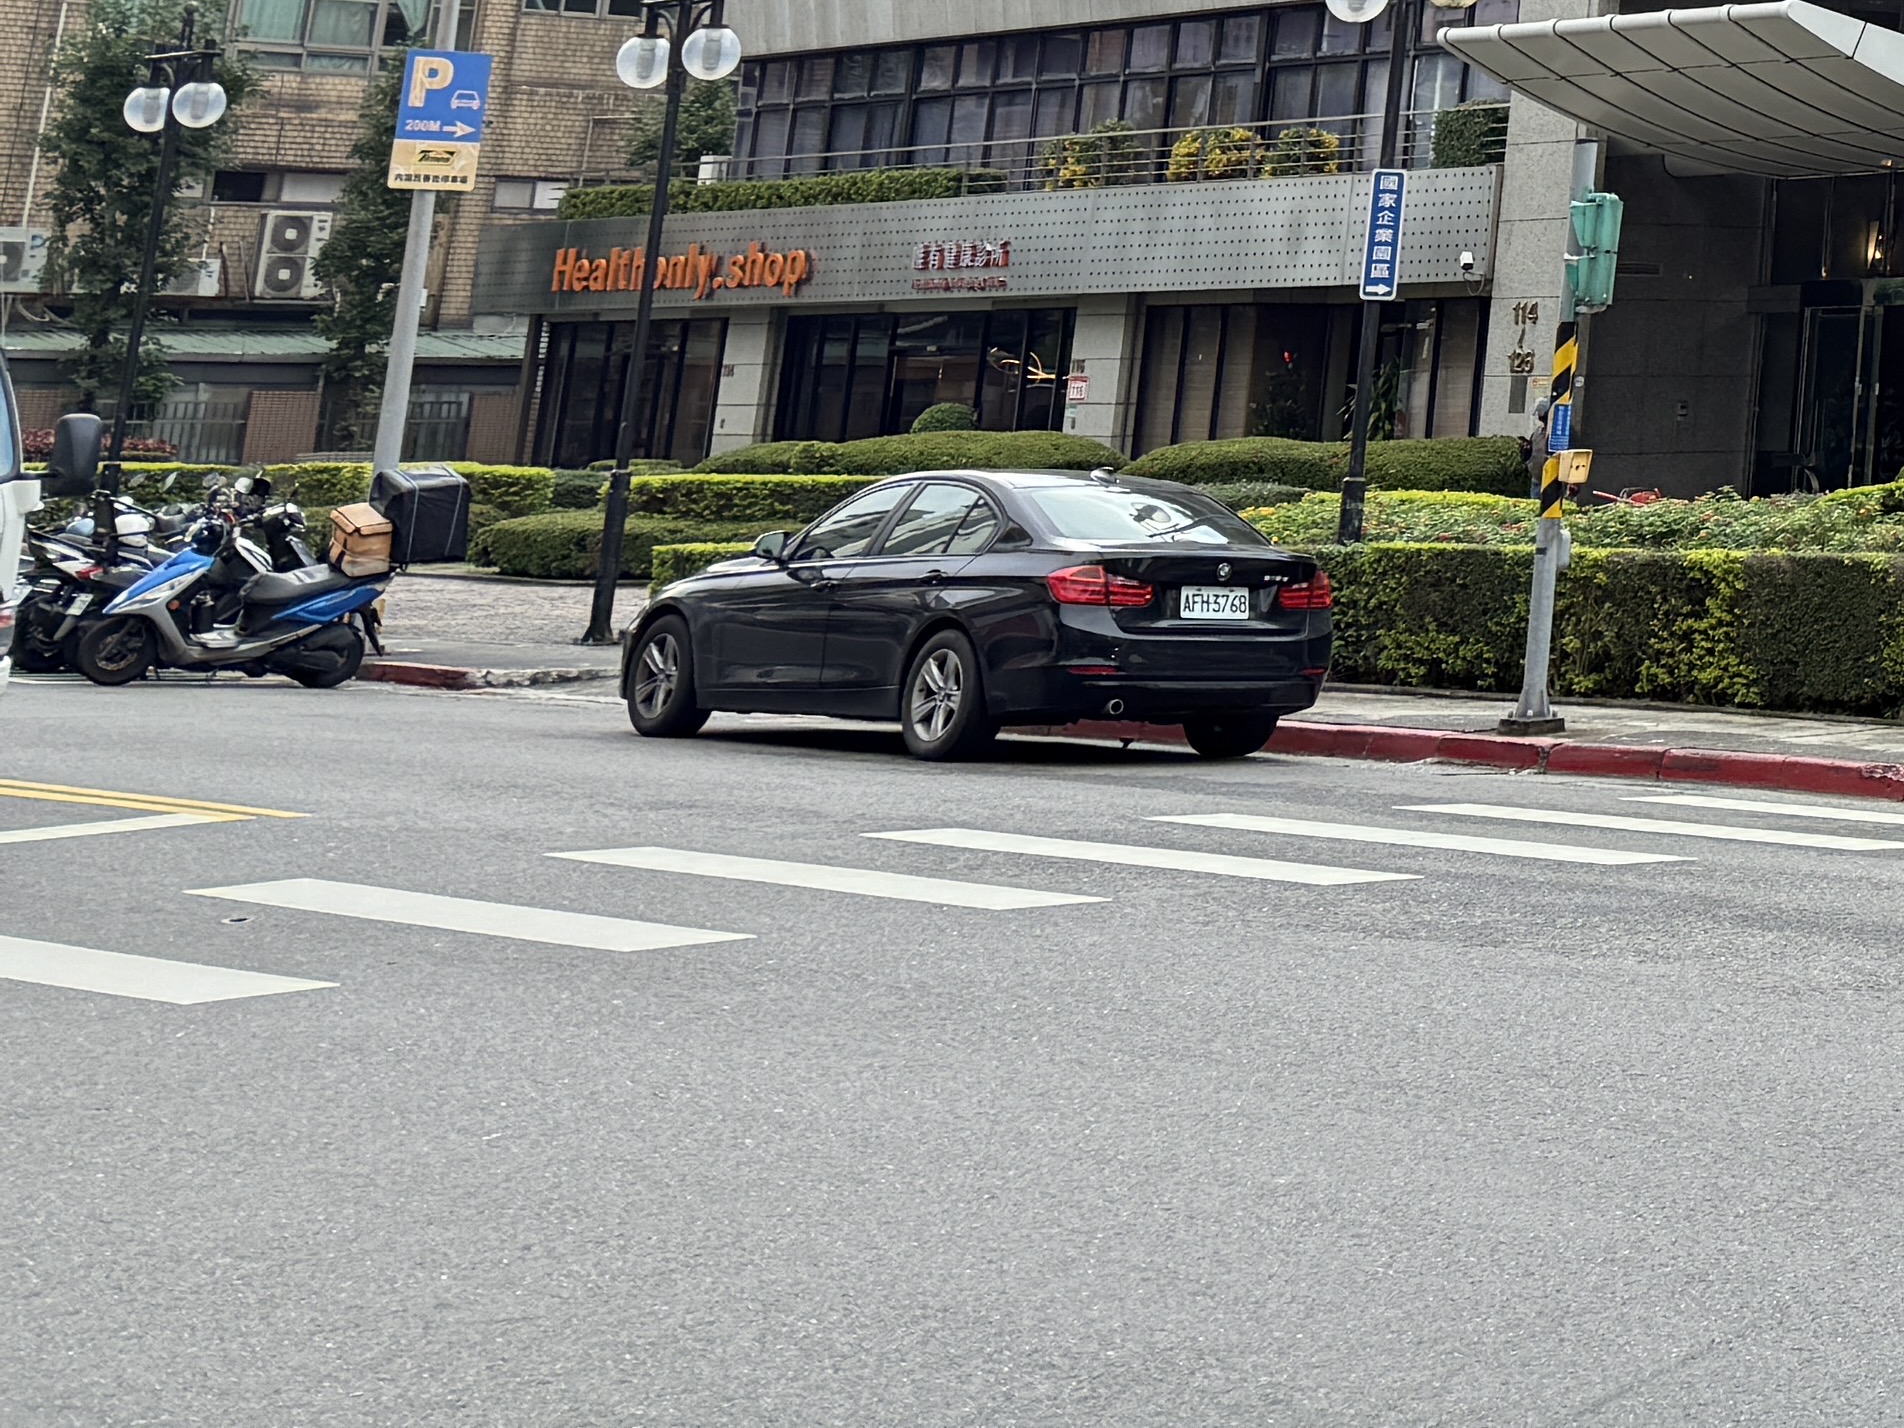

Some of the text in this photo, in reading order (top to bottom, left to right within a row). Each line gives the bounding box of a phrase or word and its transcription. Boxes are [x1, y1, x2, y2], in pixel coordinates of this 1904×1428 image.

[407, 55, 455, 108] P
[1369, 175, 1399, 278] 國家企業園區
[1511, 301, 1539, 326] 114
[1182, 593, 1248, 614] AFH-3768
